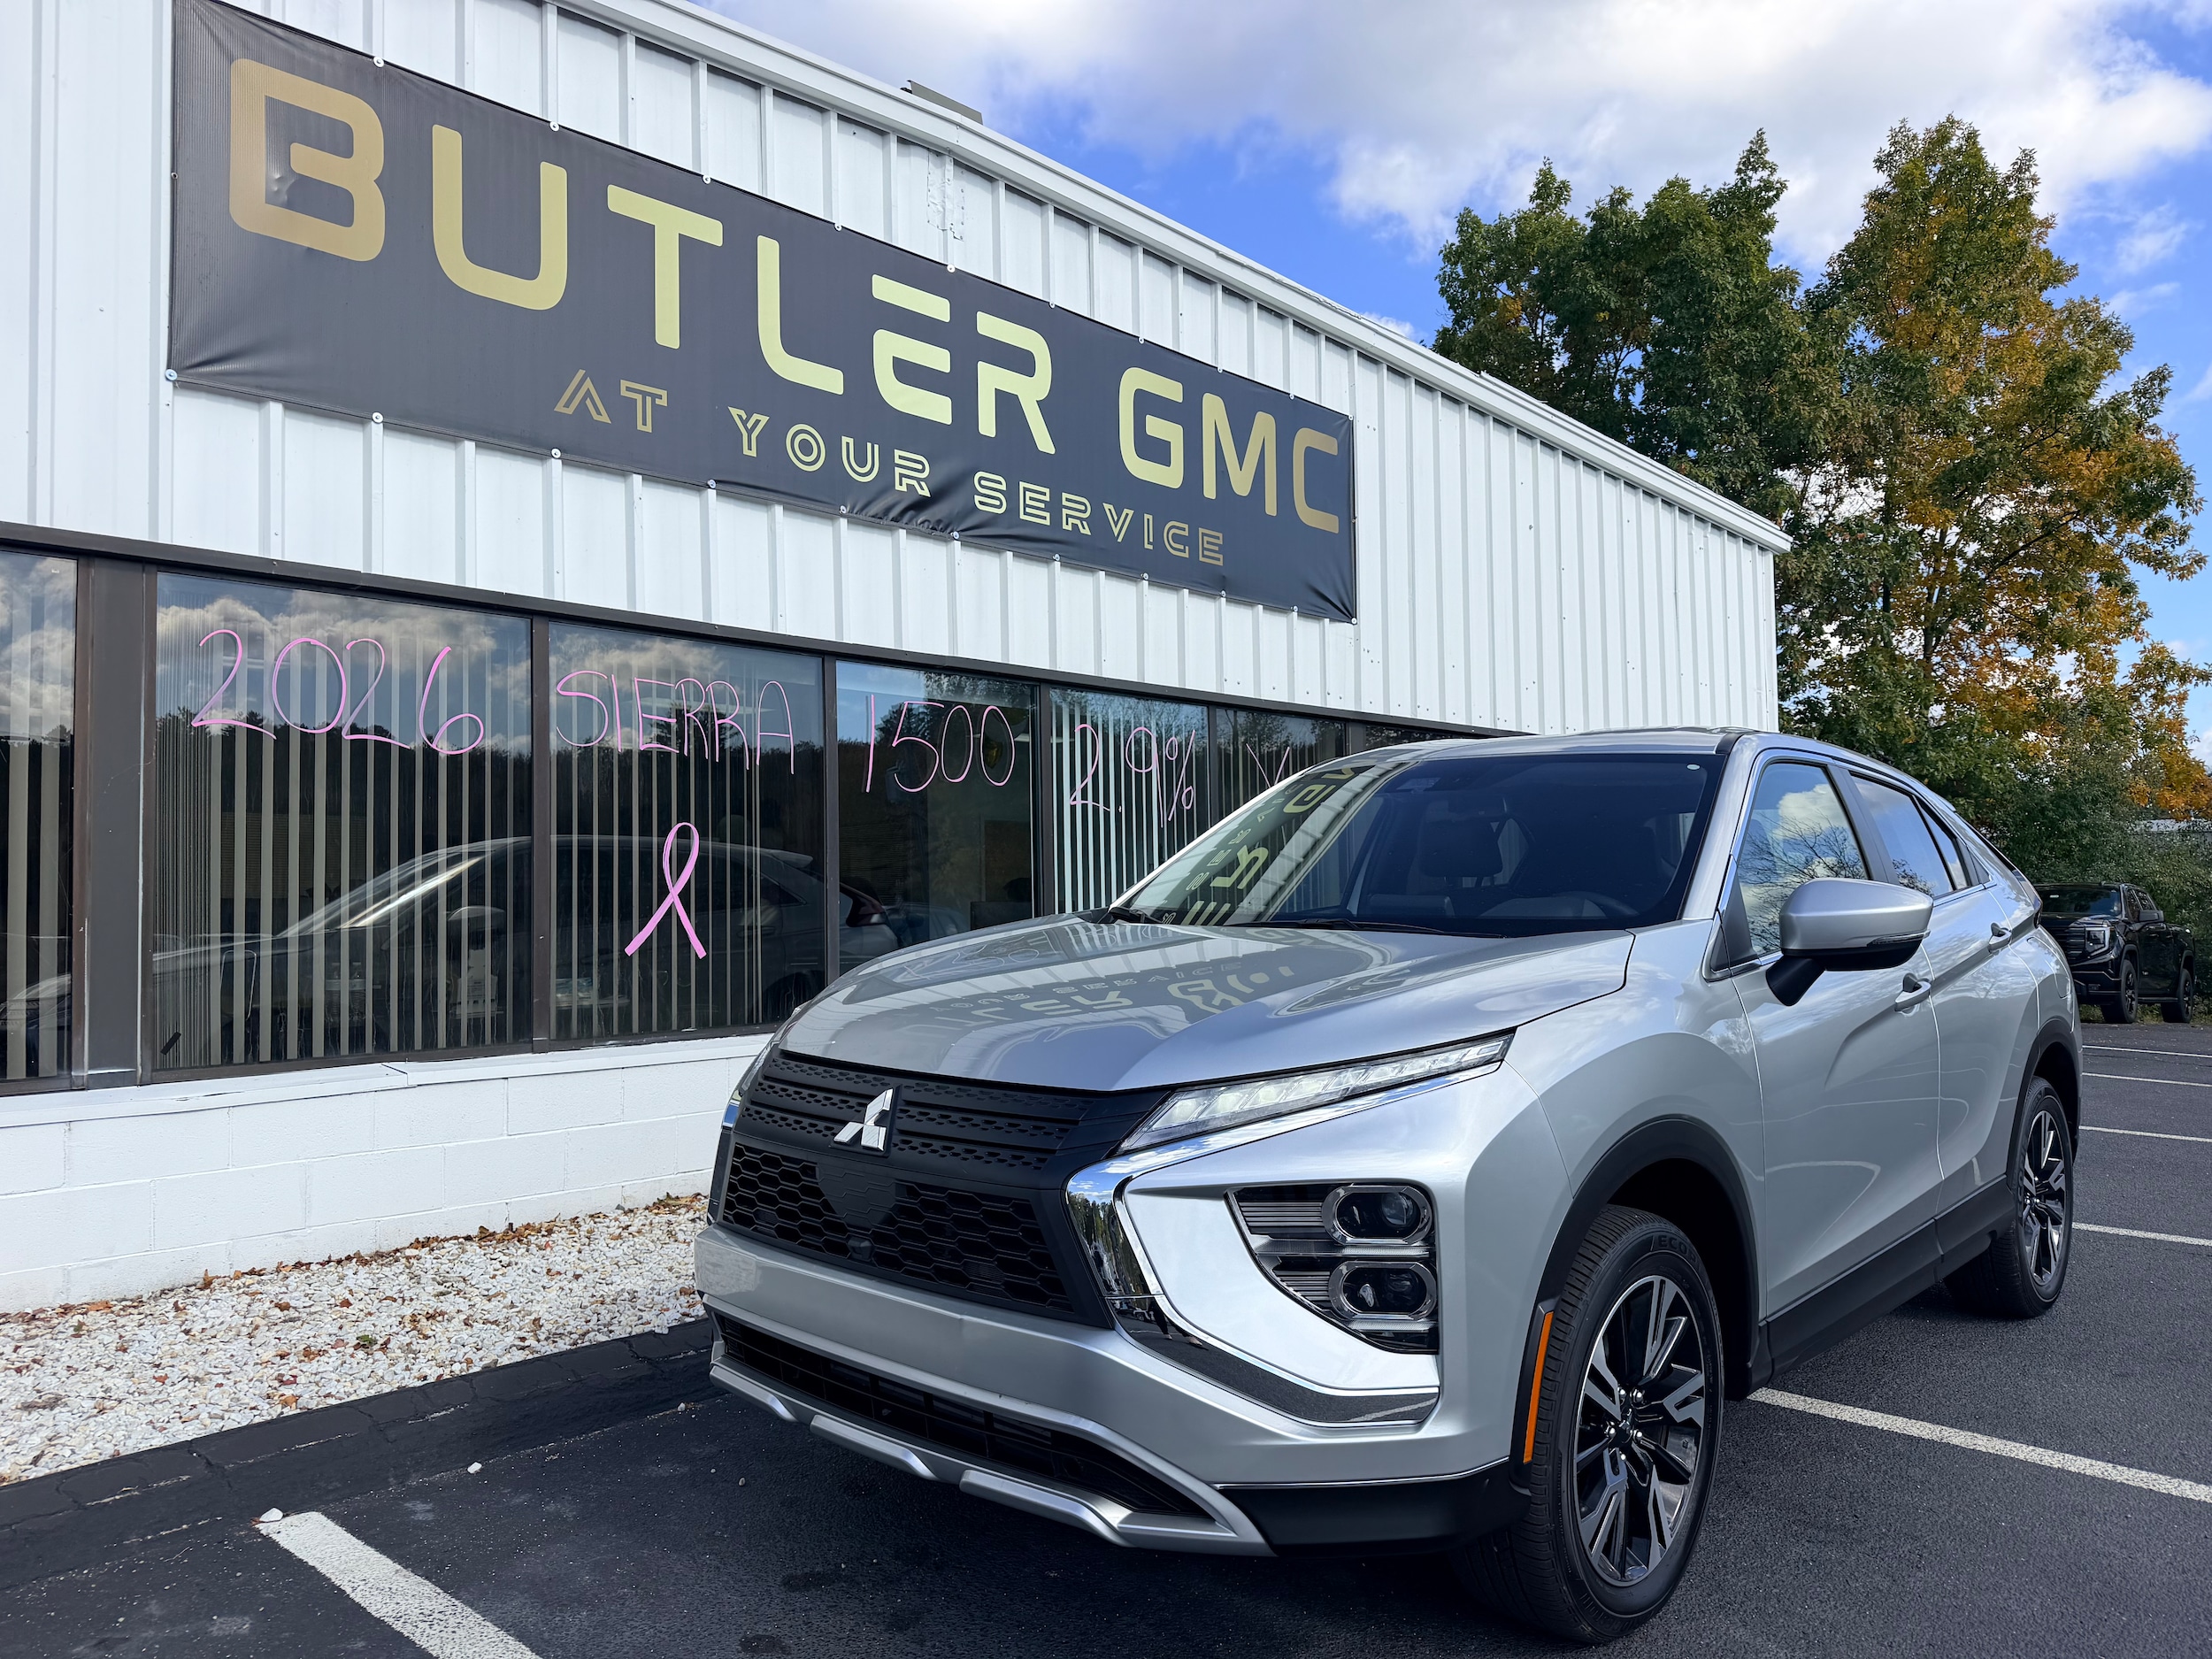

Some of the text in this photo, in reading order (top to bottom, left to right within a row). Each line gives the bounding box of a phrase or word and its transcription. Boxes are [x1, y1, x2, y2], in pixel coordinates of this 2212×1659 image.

[228, 58, 1340, 534] BUTLER GMC
[554, 369, 1224, 566] AT YOUR SERVICE
[190, 628, 485, 755] 2026
[556, 670, 795, 774] SIERRA
[865, 695, 1016, 794] 1500
[1070, 724, 1196, 828] 2.9%
